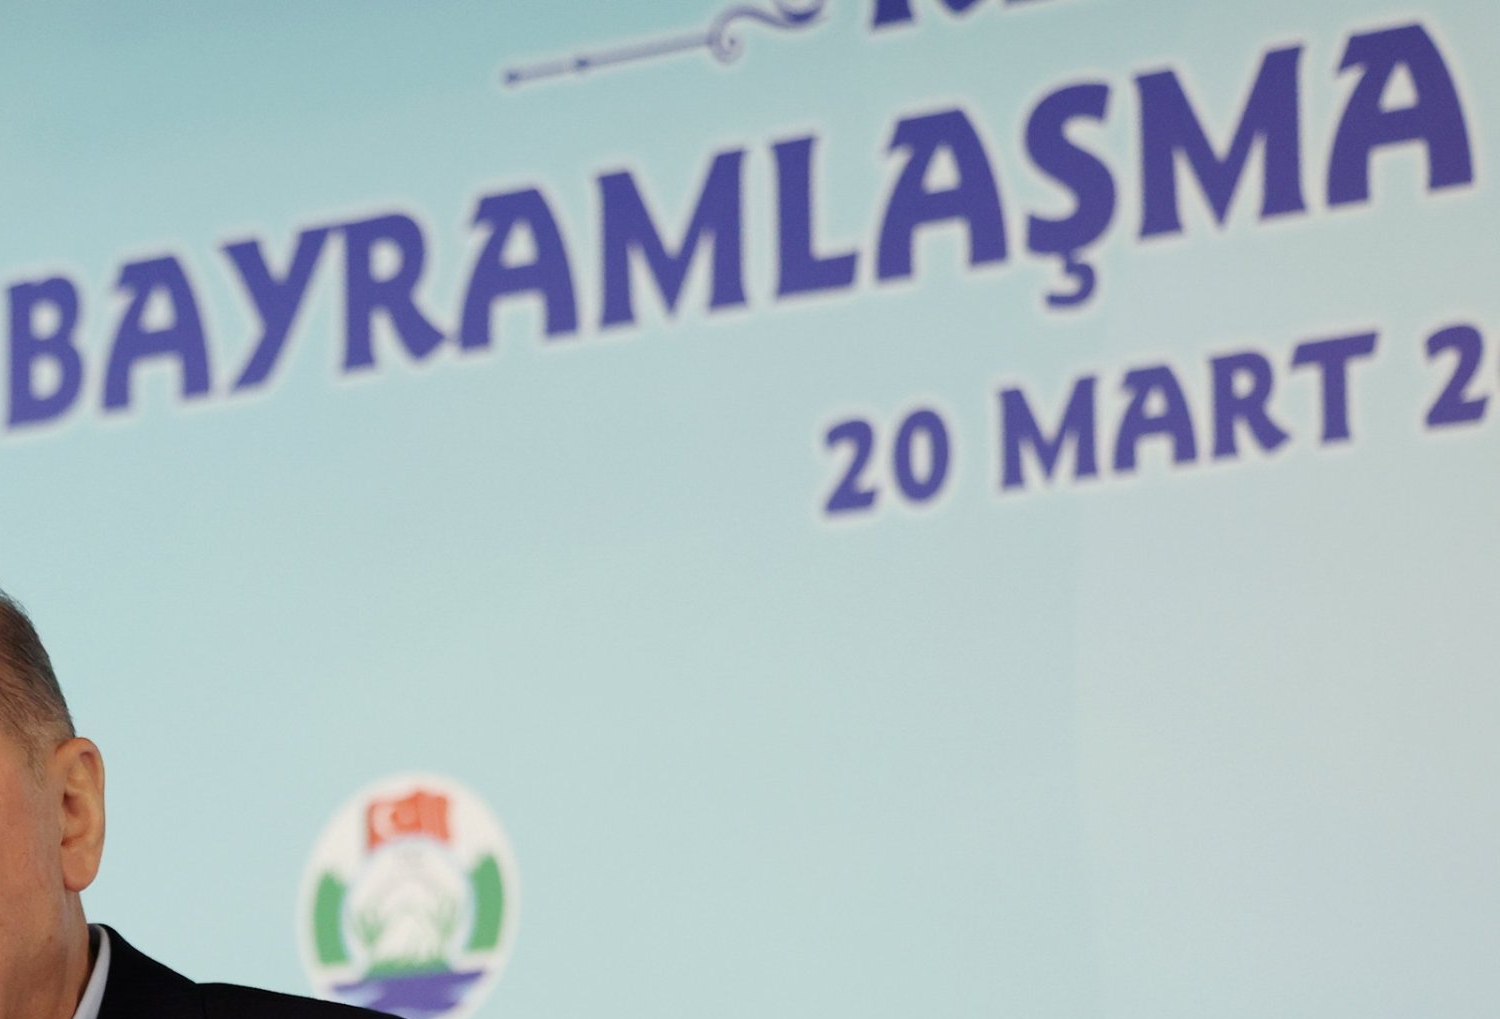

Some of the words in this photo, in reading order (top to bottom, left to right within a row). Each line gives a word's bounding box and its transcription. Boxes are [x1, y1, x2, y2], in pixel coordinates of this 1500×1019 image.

[4, 20, 1476, 430] BAYRAMLAŞMA
[822, 406, 952, 516] 20
[997, 329, 1380, 491] MART
[1423, 322, 1500, 429] 2
